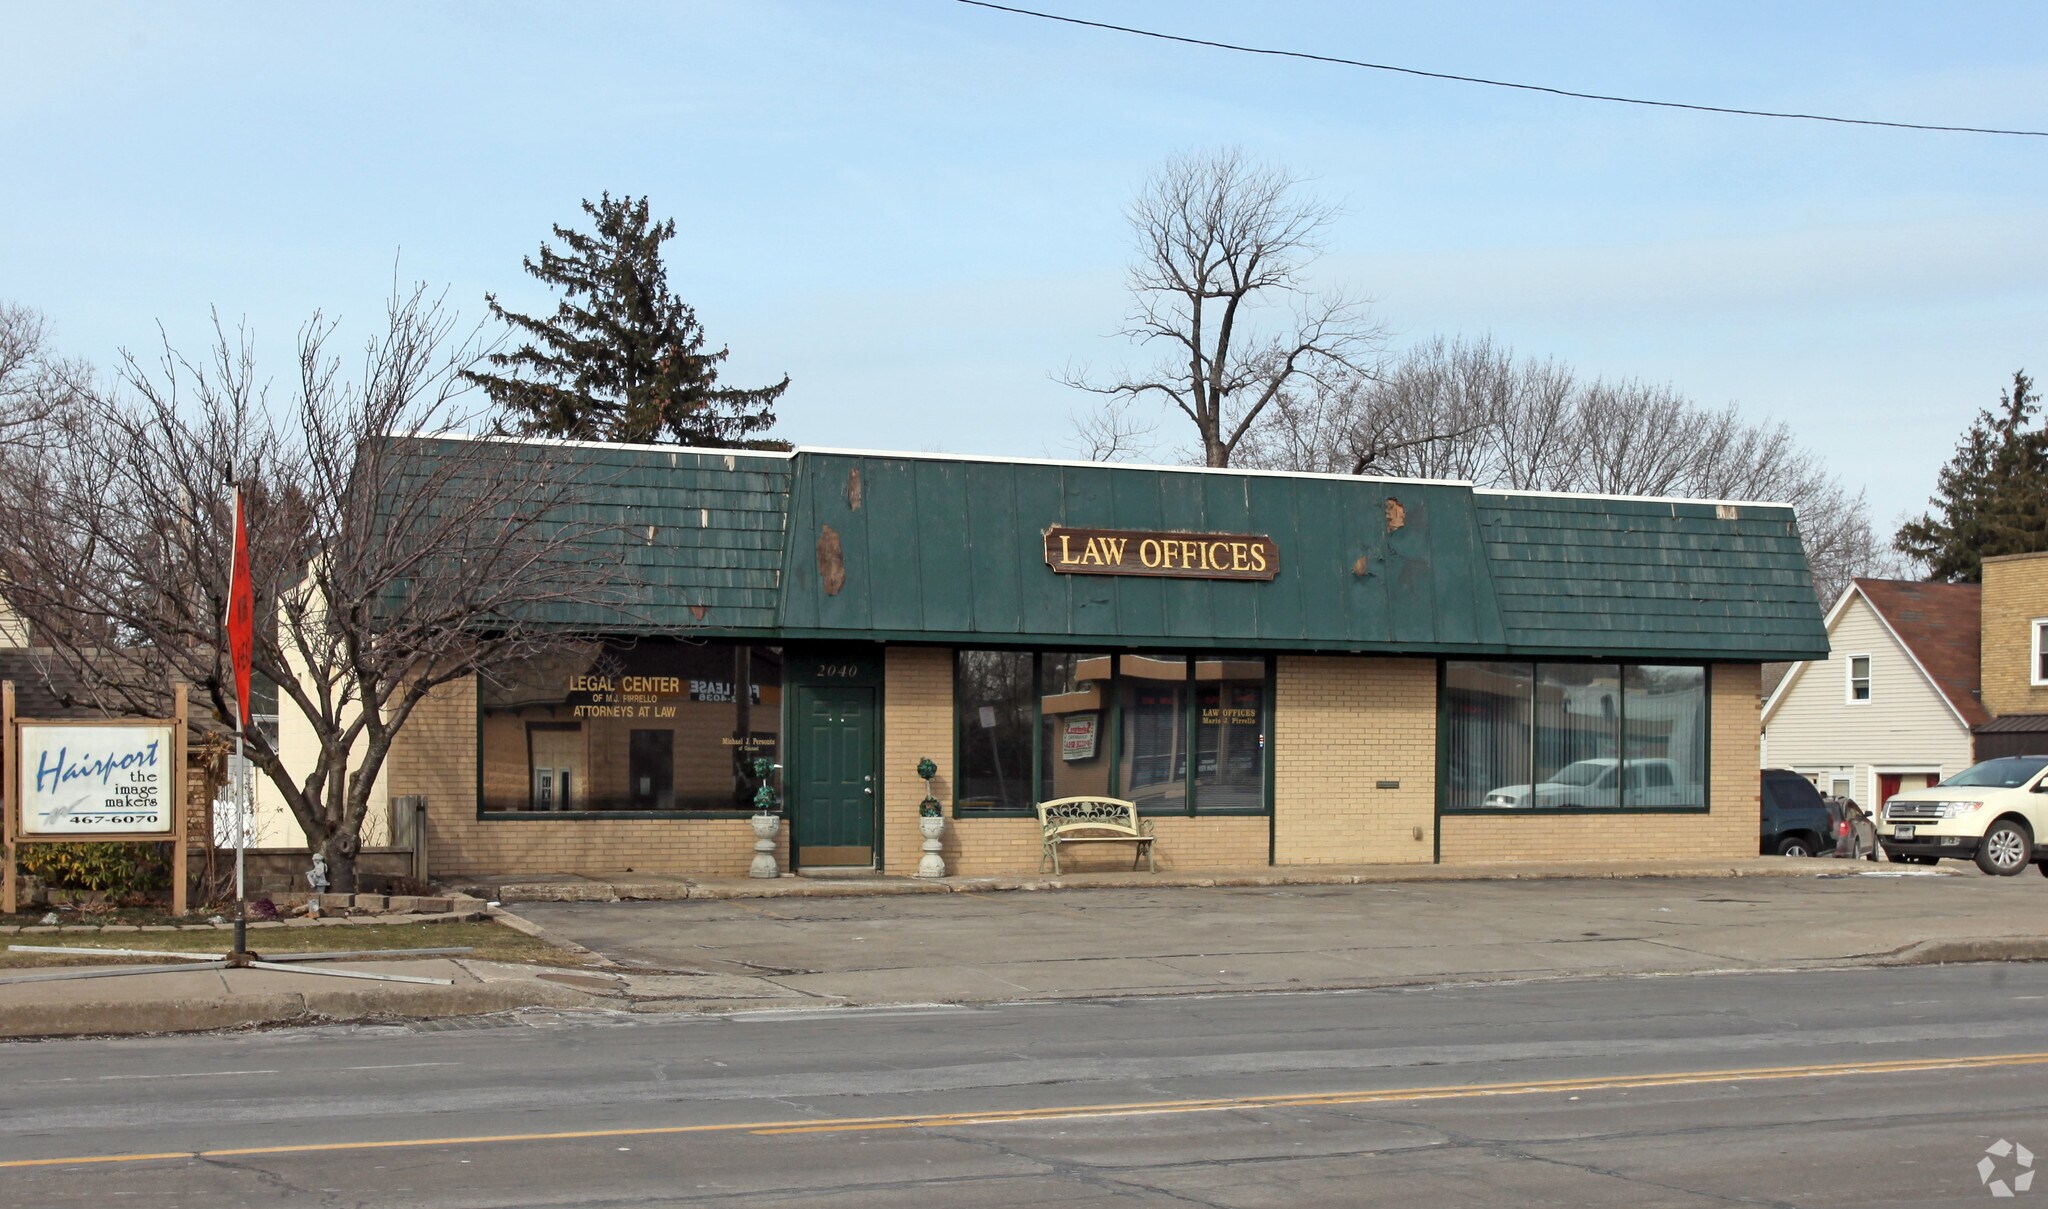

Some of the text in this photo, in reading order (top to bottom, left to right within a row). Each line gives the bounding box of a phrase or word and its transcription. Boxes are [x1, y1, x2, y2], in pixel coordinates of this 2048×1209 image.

[1059, 535, 1267, 571] LAW OFFICES
[817, 664, 858, 677] 2040
[569, 675, 680, 693] LEGAL CENTER
[592, 693, 603, 703] OF
[573, 705, 677, 718] ATTORNEYS AT LAW
[1202, 709, 1256, 717] LAW OFFICES
[36, 739, 159, 795] Hairport
[130, 770, 158, 782] the
[115, 783, 158, 799] image
[105, 794, 158, 808] makers
[69, 815, 158, 824] 467-6070
